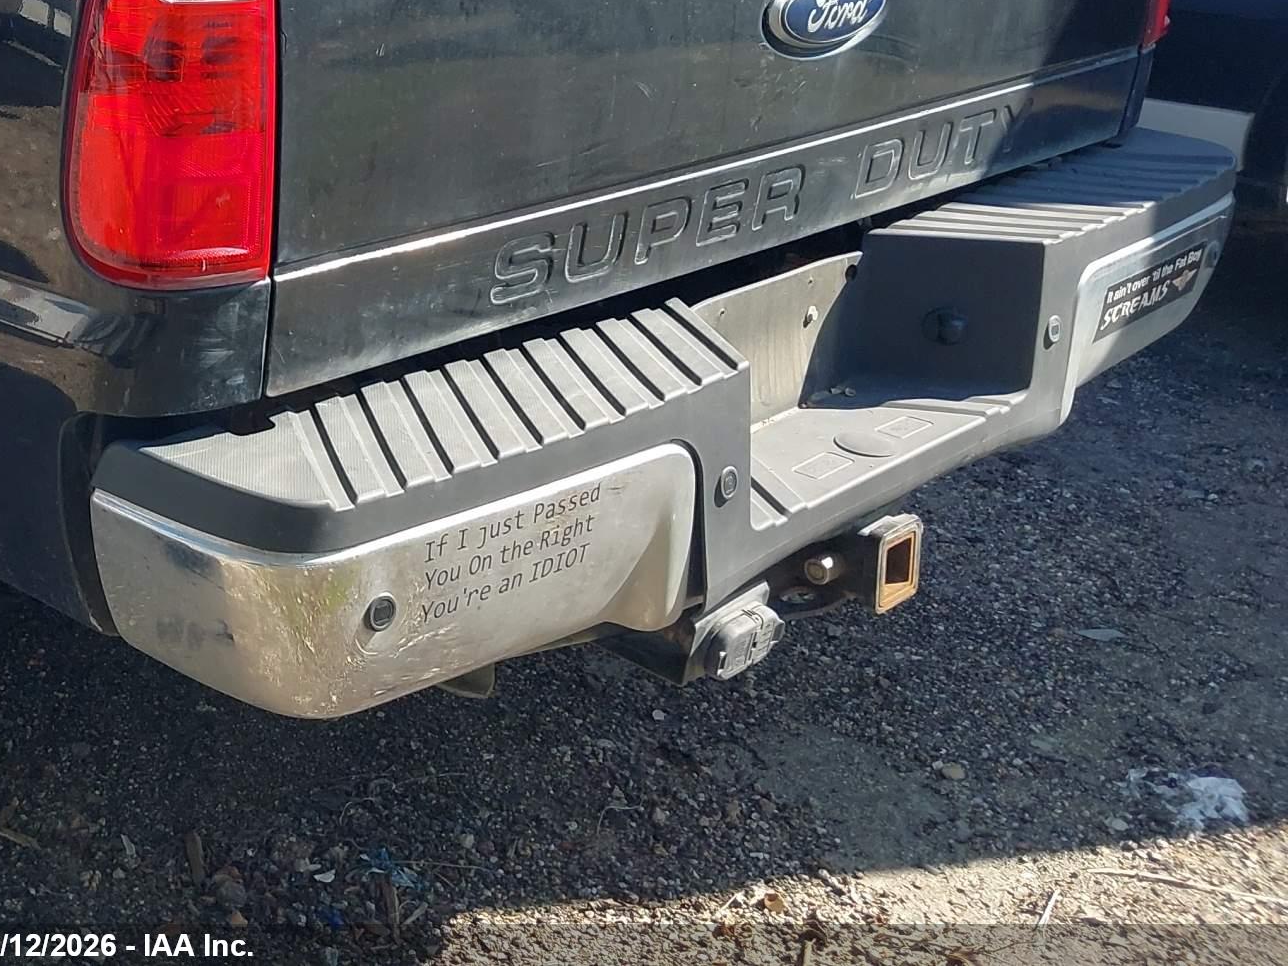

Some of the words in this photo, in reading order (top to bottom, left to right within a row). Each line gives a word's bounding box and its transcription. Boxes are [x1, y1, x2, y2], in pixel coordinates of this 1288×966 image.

[489, 163, 807, 306] SUPER
[853, 97, 1034, 200] DUTY
[1099, 279, 1171, 331] SCREAMS
[424, 533, 449, 563] If
[457, 528, 469, 551] I
[533, 481, 602, 524] Passed
[424, 564, 461, 591] You
[469, 554, 493, 576] On
[500, 539, 534, 564] the
[539, 514, 596, 551] Right
[421, 584, 492, 623] You're
[498, 572, 523, 594] an
[528, 541, 591, 584] IDIOT
